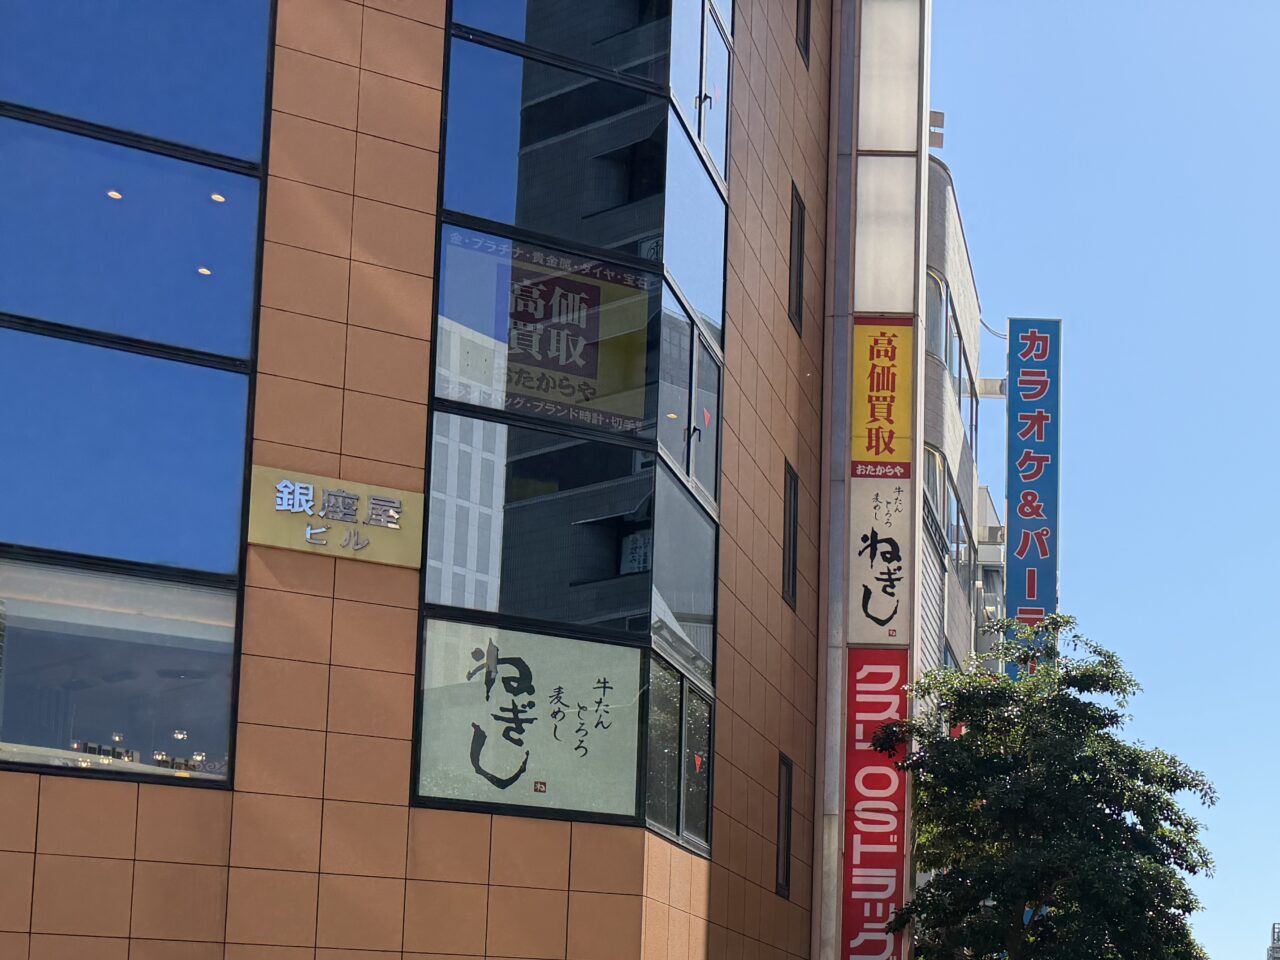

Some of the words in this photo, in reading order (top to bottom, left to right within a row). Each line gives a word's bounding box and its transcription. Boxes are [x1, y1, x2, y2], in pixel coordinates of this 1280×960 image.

[866, 331, 898, 456] 高価買取
[855, 464, 904, 476] おたからや
[275, 478, 403, 530] 銀座屋
[893, 486, 904, 513] 牛たん
[305, 523, 370, 552] ビル
[858, 527, 904, 627] ねぎし
[466, 638, 538, 790] ねぎし
[549, 686, 570, 741] 麦めし
[574, 702, 588, 758] とろろ
[592, 677, 614, 730] 牛たん
